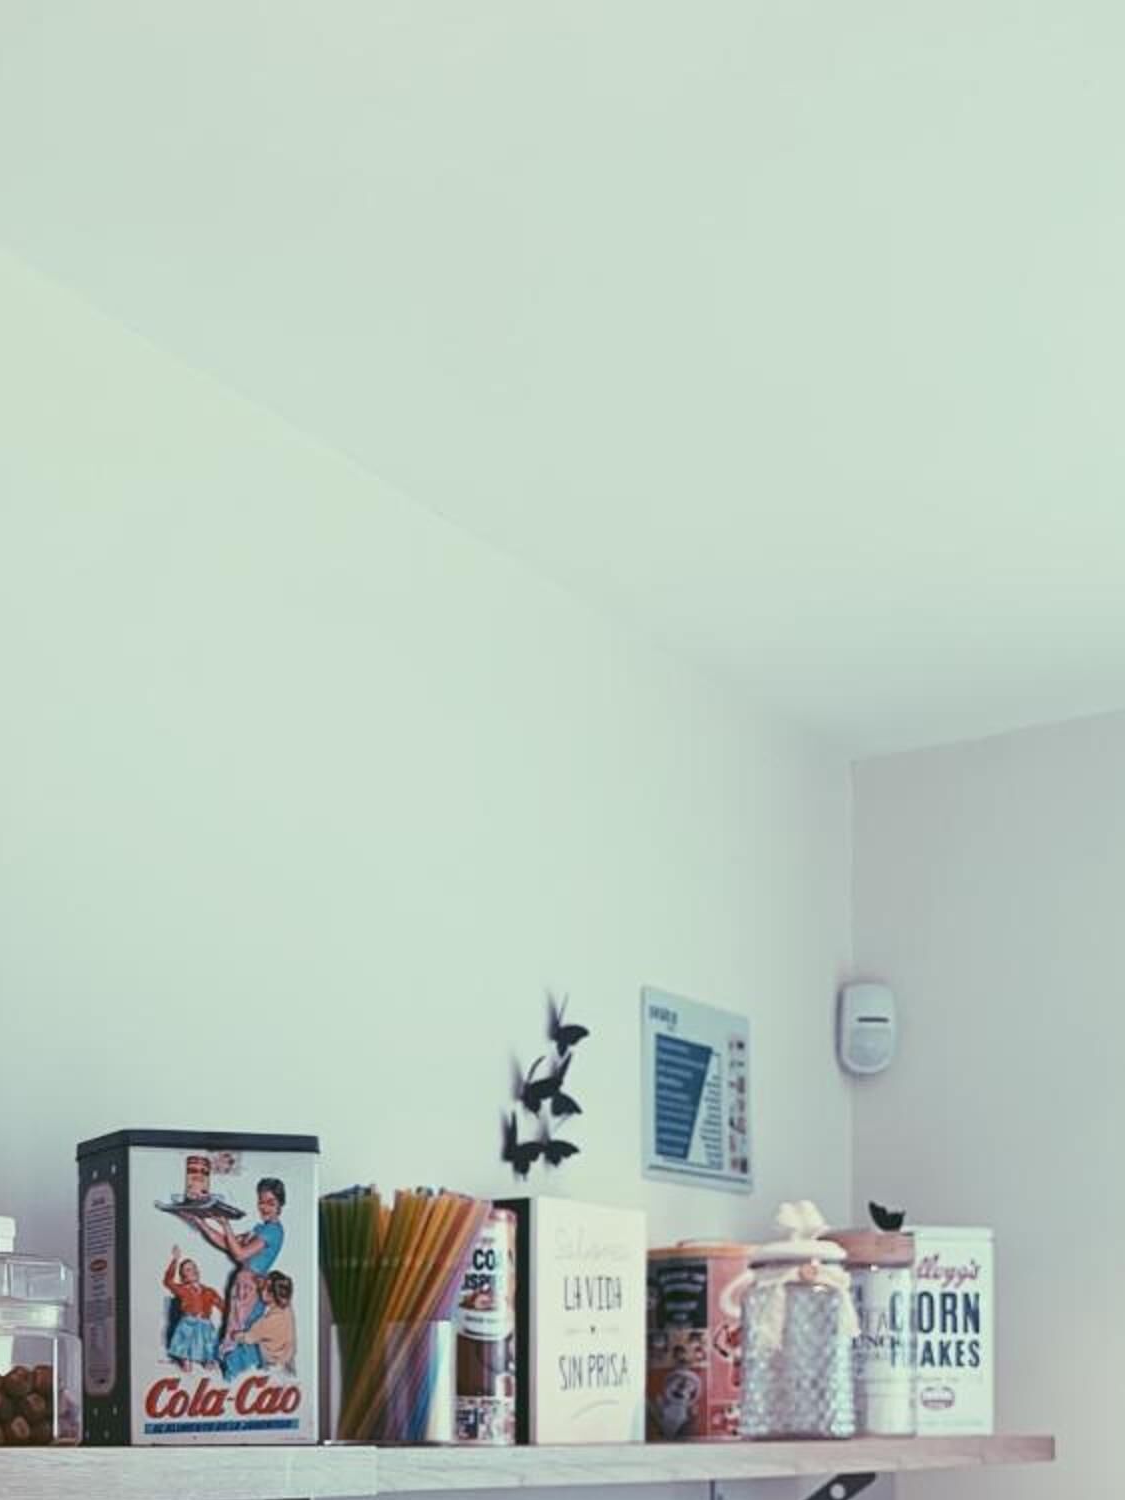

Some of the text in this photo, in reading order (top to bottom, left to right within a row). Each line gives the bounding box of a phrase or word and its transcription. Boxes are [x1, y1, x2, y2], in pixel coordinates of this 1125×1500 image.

[563, 1276, 581, 1311] LA
[585, 1276, 623, 1311] VIDA
[889, 1291, 981, 1335] CORN
[558, 1352, 629, 1391] SIN PRISA
[144, 1374, 303, 1420] Cola-Cao
